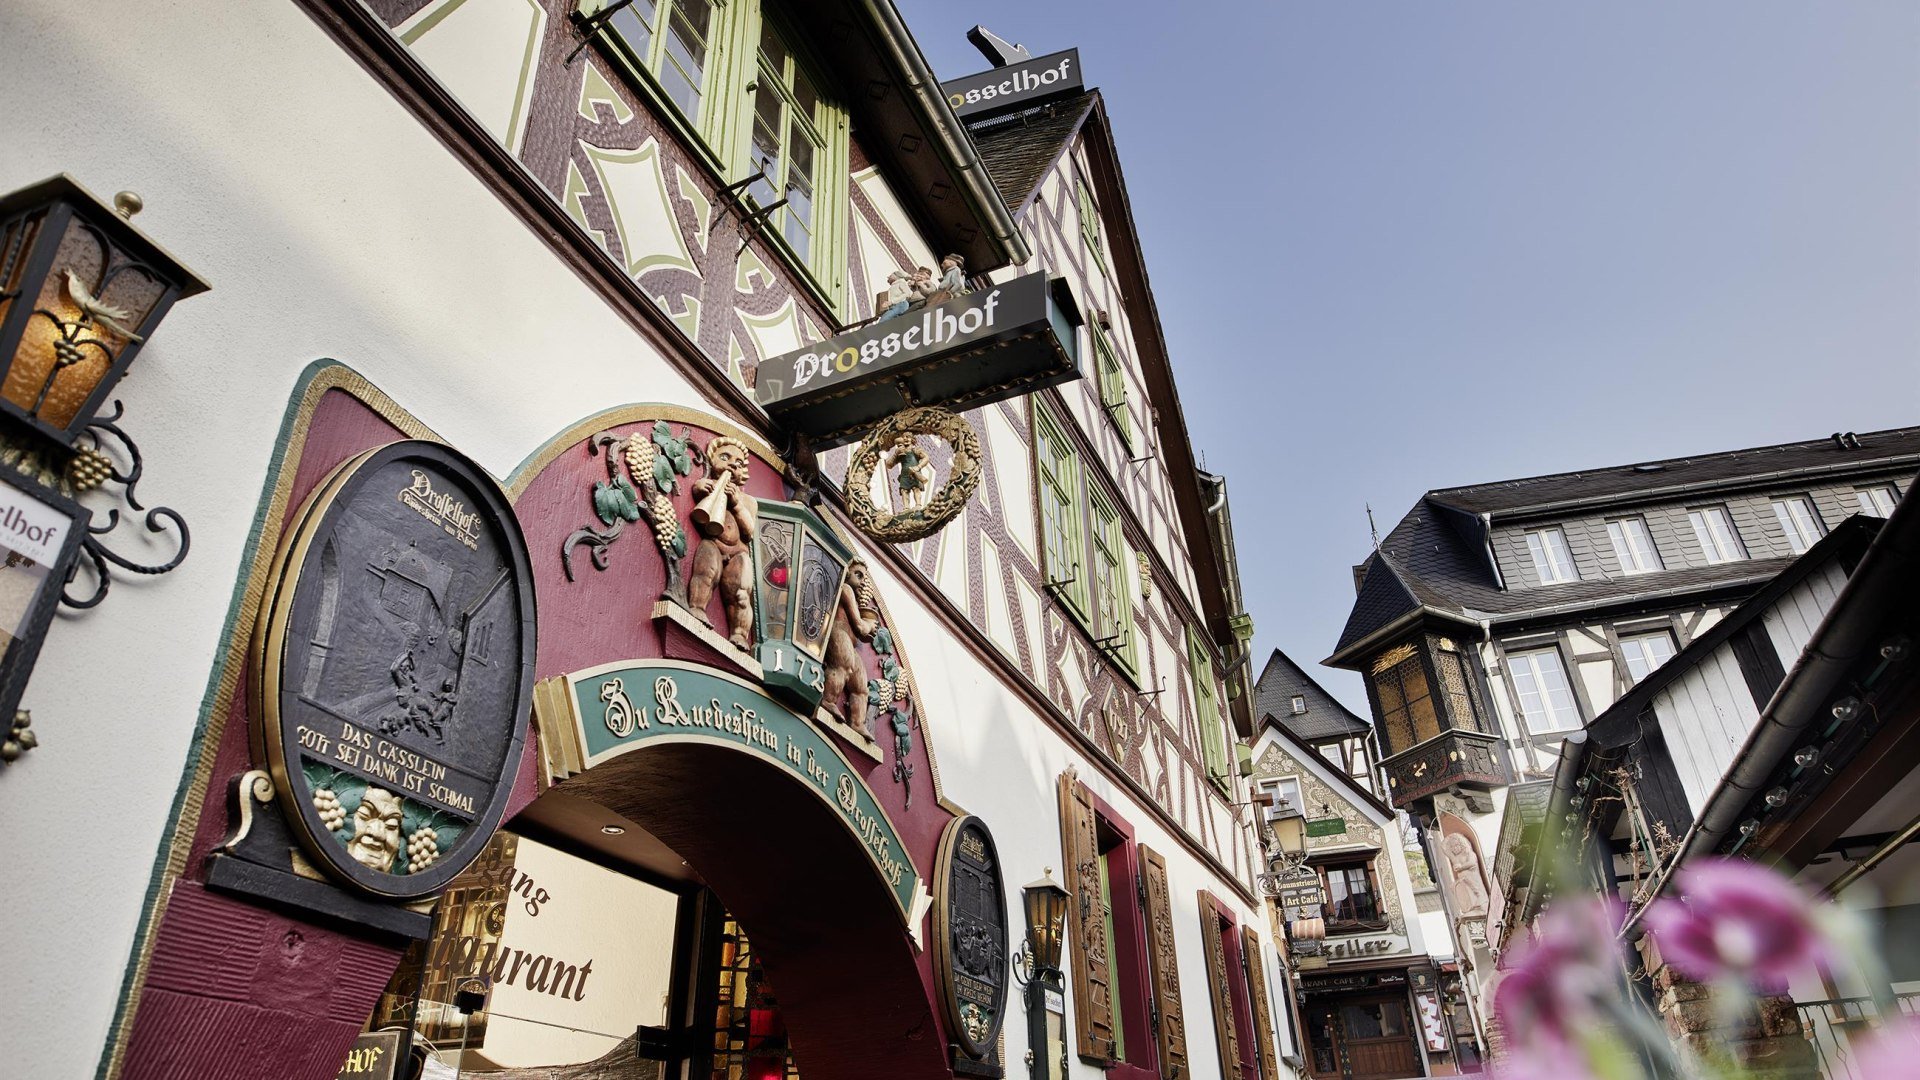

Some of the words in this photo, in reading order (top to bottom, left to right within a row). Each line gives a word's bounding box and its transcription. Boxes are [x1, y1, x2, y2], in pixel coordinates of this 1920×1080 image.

[949, 58, 1071, 109] osselhof
[791, 289, 1001, 389] Drosselhof
[0, 505, 57, 546] lhof
[341, 723, 373, 749] DAS
[377, 740, 447, 780] GÄSSLEIN
[600, 677, 651, 738] Zu
[655, 676, 778, 751] Ruedesheim
[787, 734, 801, 766] in
[807, 747, 830, 787] der
[297, 725, 331, 754] GOTT
[335, 743, 361, 767] SEI
[362, 754, 400, 784] DANK
[402, 771, 426, 795] IST
[428, 782, 476, 815] SCHMAL
[1287, 897, 1300, 906] Art
[1301, 894, 1319, 904] Café
[432, 923, 593, 1002] taurant
[339, 1047, 385, 1073] HOF
